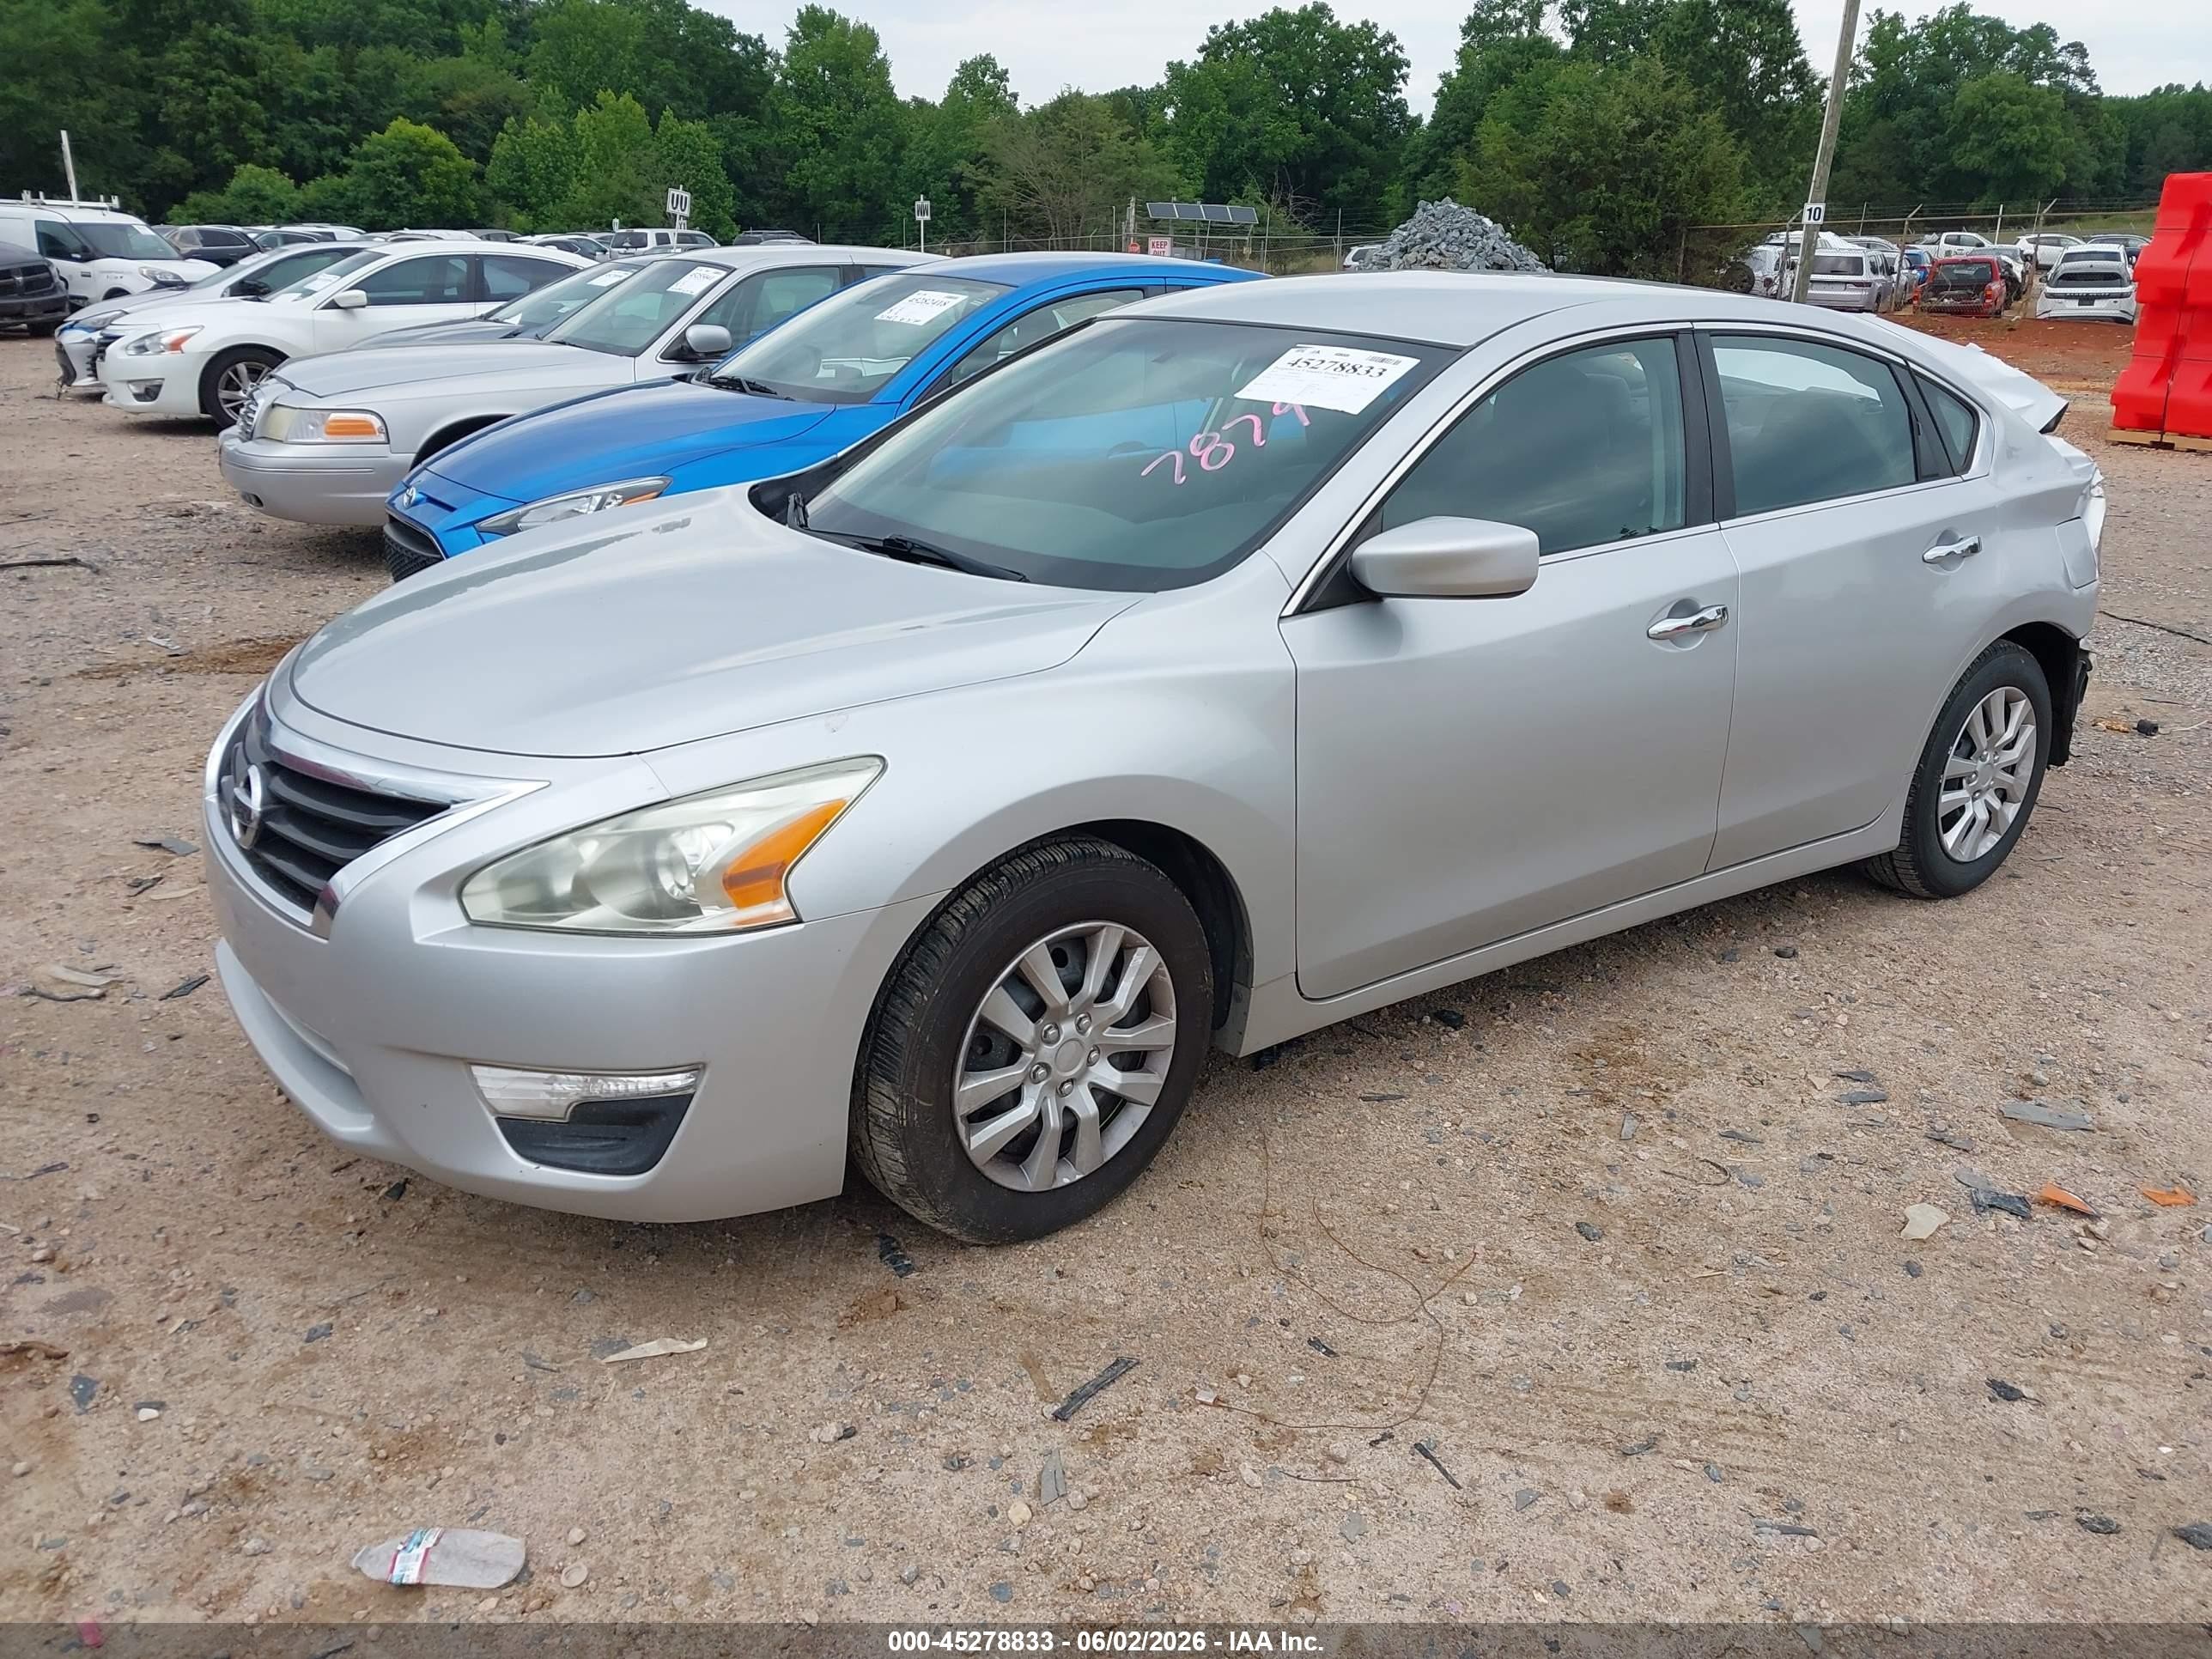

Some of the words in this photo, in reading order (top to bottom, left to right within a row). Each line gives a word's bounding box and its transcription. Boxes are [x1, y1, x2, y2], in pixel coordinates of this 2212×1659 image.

[672, 193, 688, 211] UU
[1807, 207, 1821, 221] 10
[1152, 240, 1168, 249] KEEP
[1287, 357, 1387, 379] 45278833
